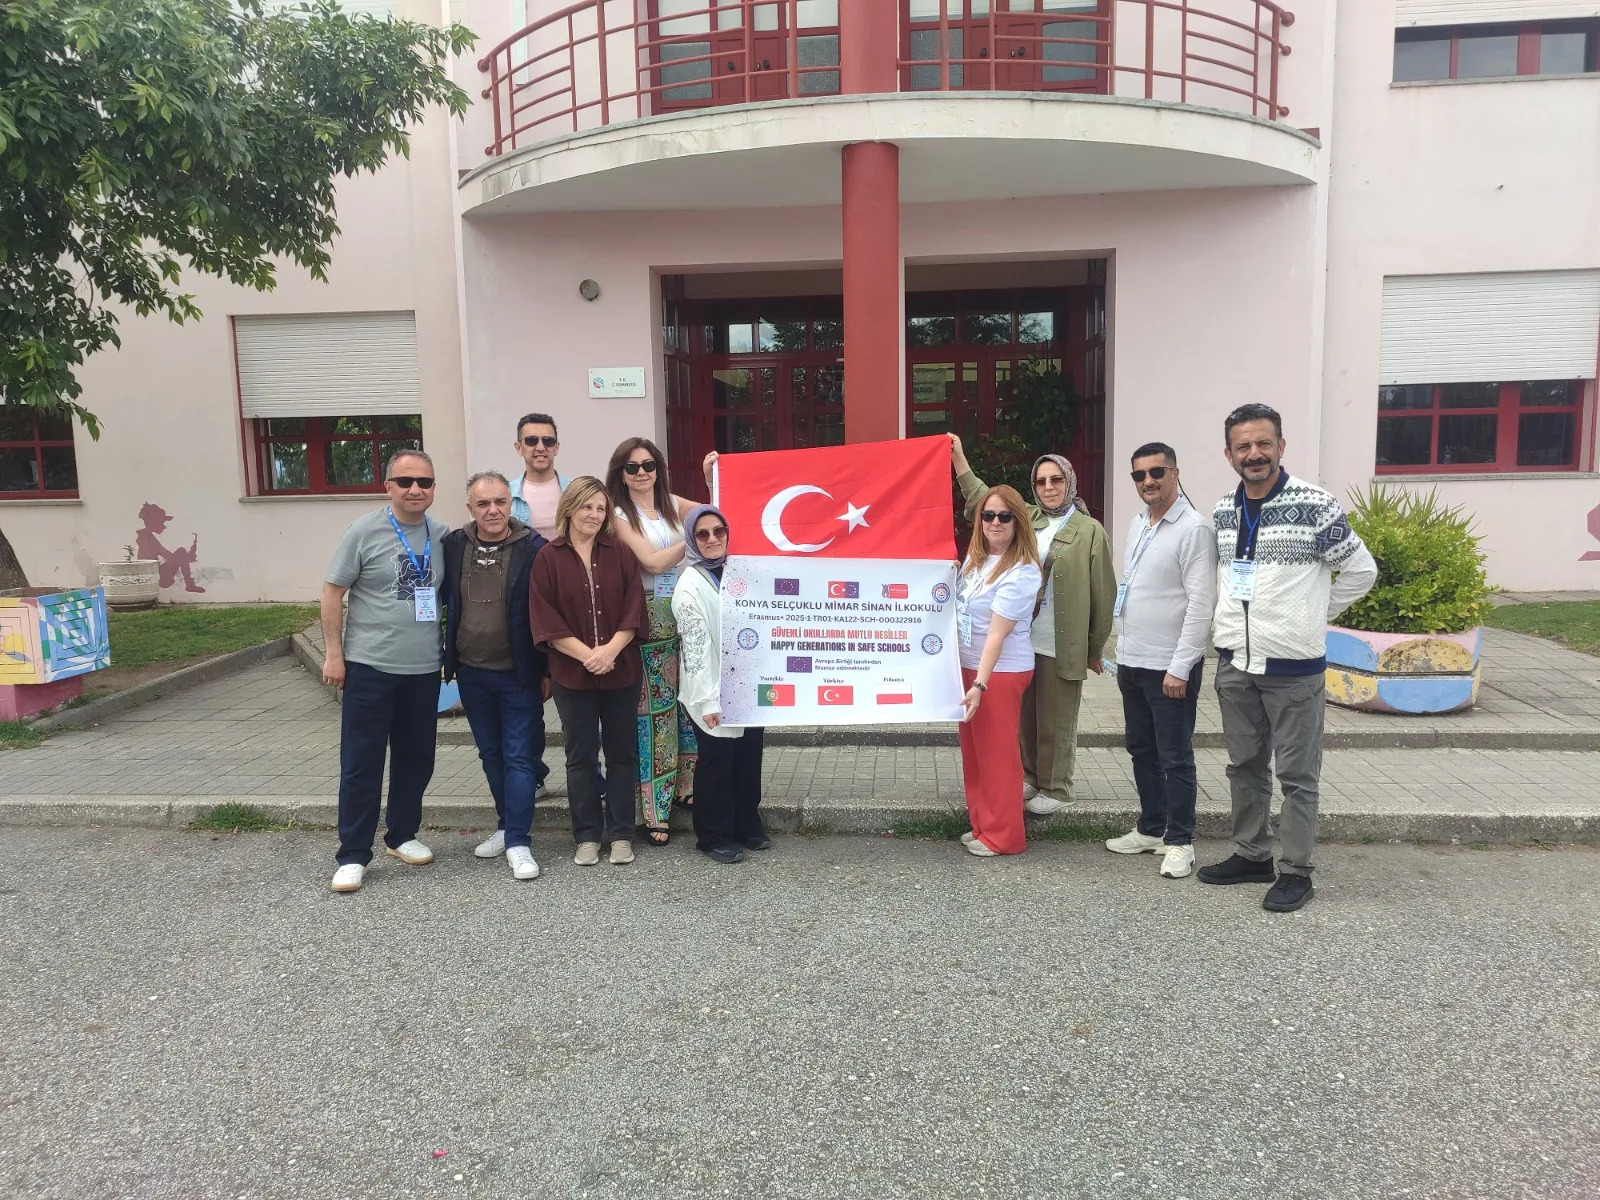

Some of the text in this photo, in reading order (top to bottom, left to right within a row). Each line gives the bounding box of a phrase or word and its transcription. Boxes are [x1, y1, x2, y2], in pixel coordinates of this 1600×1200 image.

[735, 599, 943, 613] KONYA SELÇUKLU MİMAR SİNAN İLKOKULU
[748, 613, 784, 621] Erasmus+
[771, 626, 908, 640] GÜVENLİ OKULLARDA MUTLU NESİLLER
[770, 641, 795, 651] HAPPY
[797, 641, 846, 652] GENERATIONS
[848, 642, 855, 652] IN
[857, 642, 876, 652] SAFE
[877, 643, 911, 653] SCHOOLS
